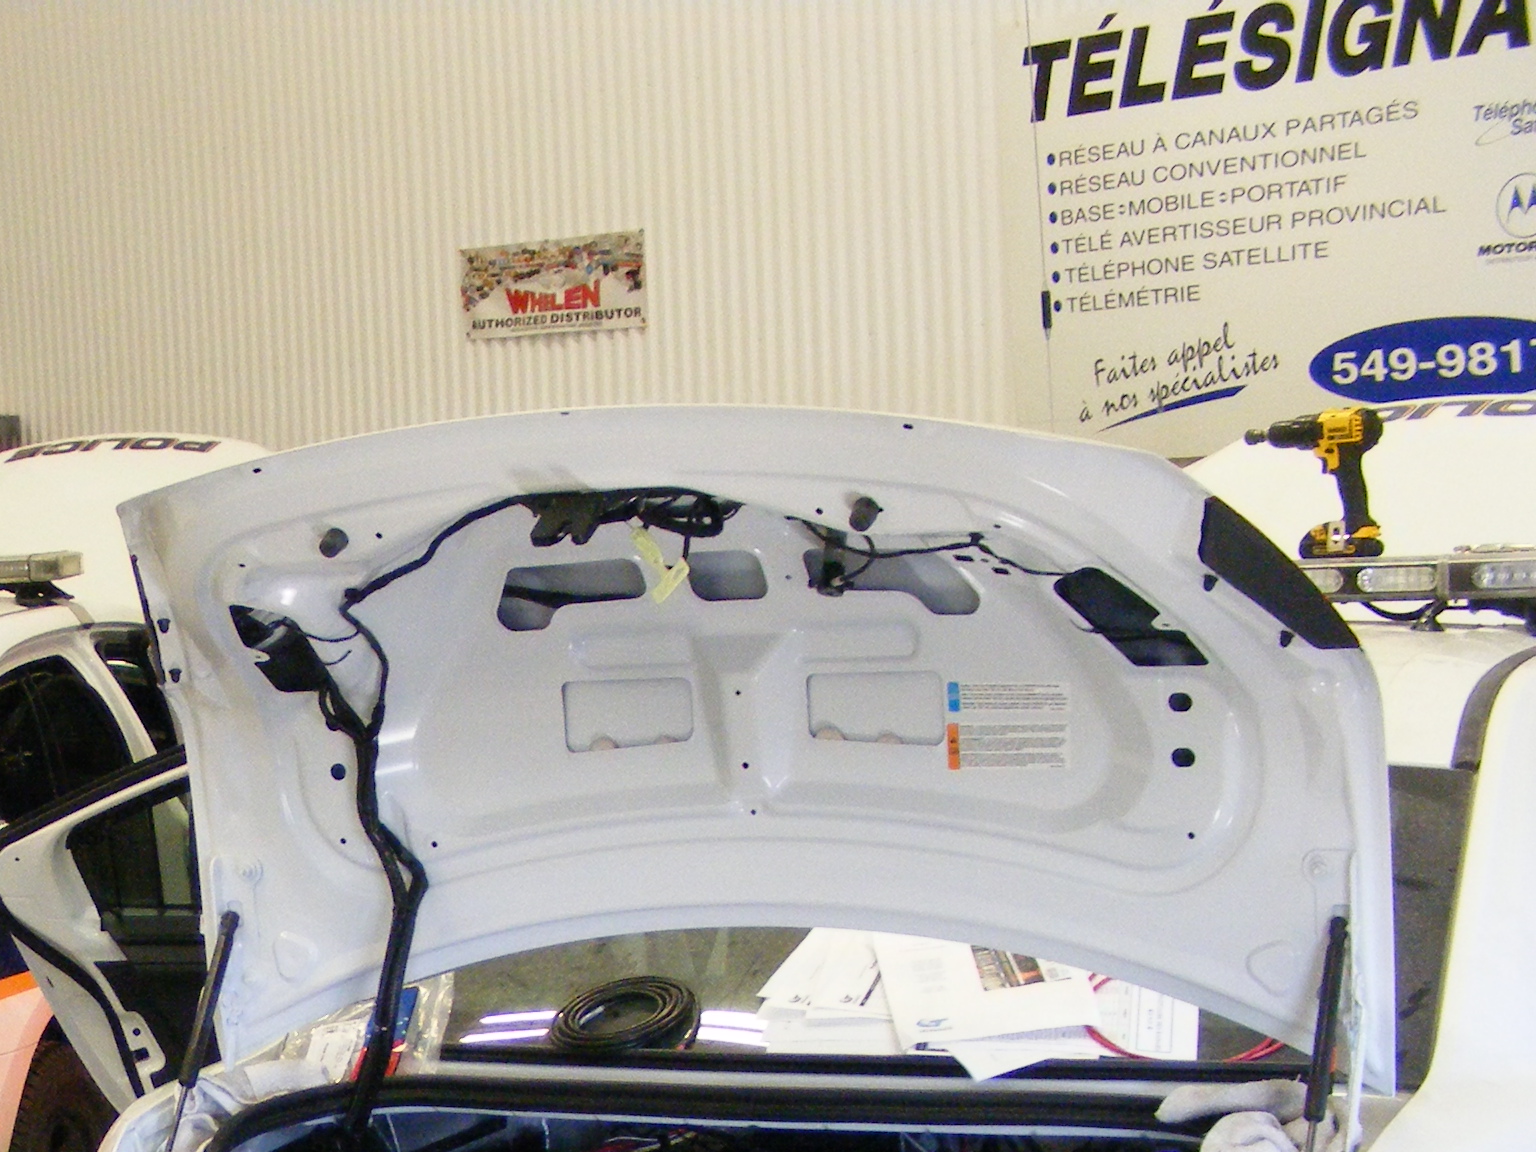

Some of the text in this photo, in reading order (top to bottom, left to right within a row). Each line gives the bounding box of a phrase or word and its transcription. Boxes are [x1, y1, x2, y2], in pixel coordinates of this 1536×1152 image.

[1058, 98, 1420, 168] RÉSEAU À CANAUX PARTAGÉS
[1059, 141, 1368, 198] RÉSEAU CONVENTIONNEL
[1061, 195, 1448, 255] TÉLÉ AVERTISSEUR PROVINCIAL
[1065, 241, 1330, 284] TÉLÉPHONE SATELLITE
[472, 315, 548, 330] AUTHORIZED
[550, 306, 642, 324] DISTRIBUTOR
[505, 279, 601, 315] WHELEN
[1066, 284, 1202, 313] TÉLÉMÉTRIE
[1094, 321, 1235, 387] Faites appel
[1331, 337, 1536, 387] 549-981
[1079, 348, 1280, 423] à nos spécialistes
[5, 436, 222, 463] POLICE
